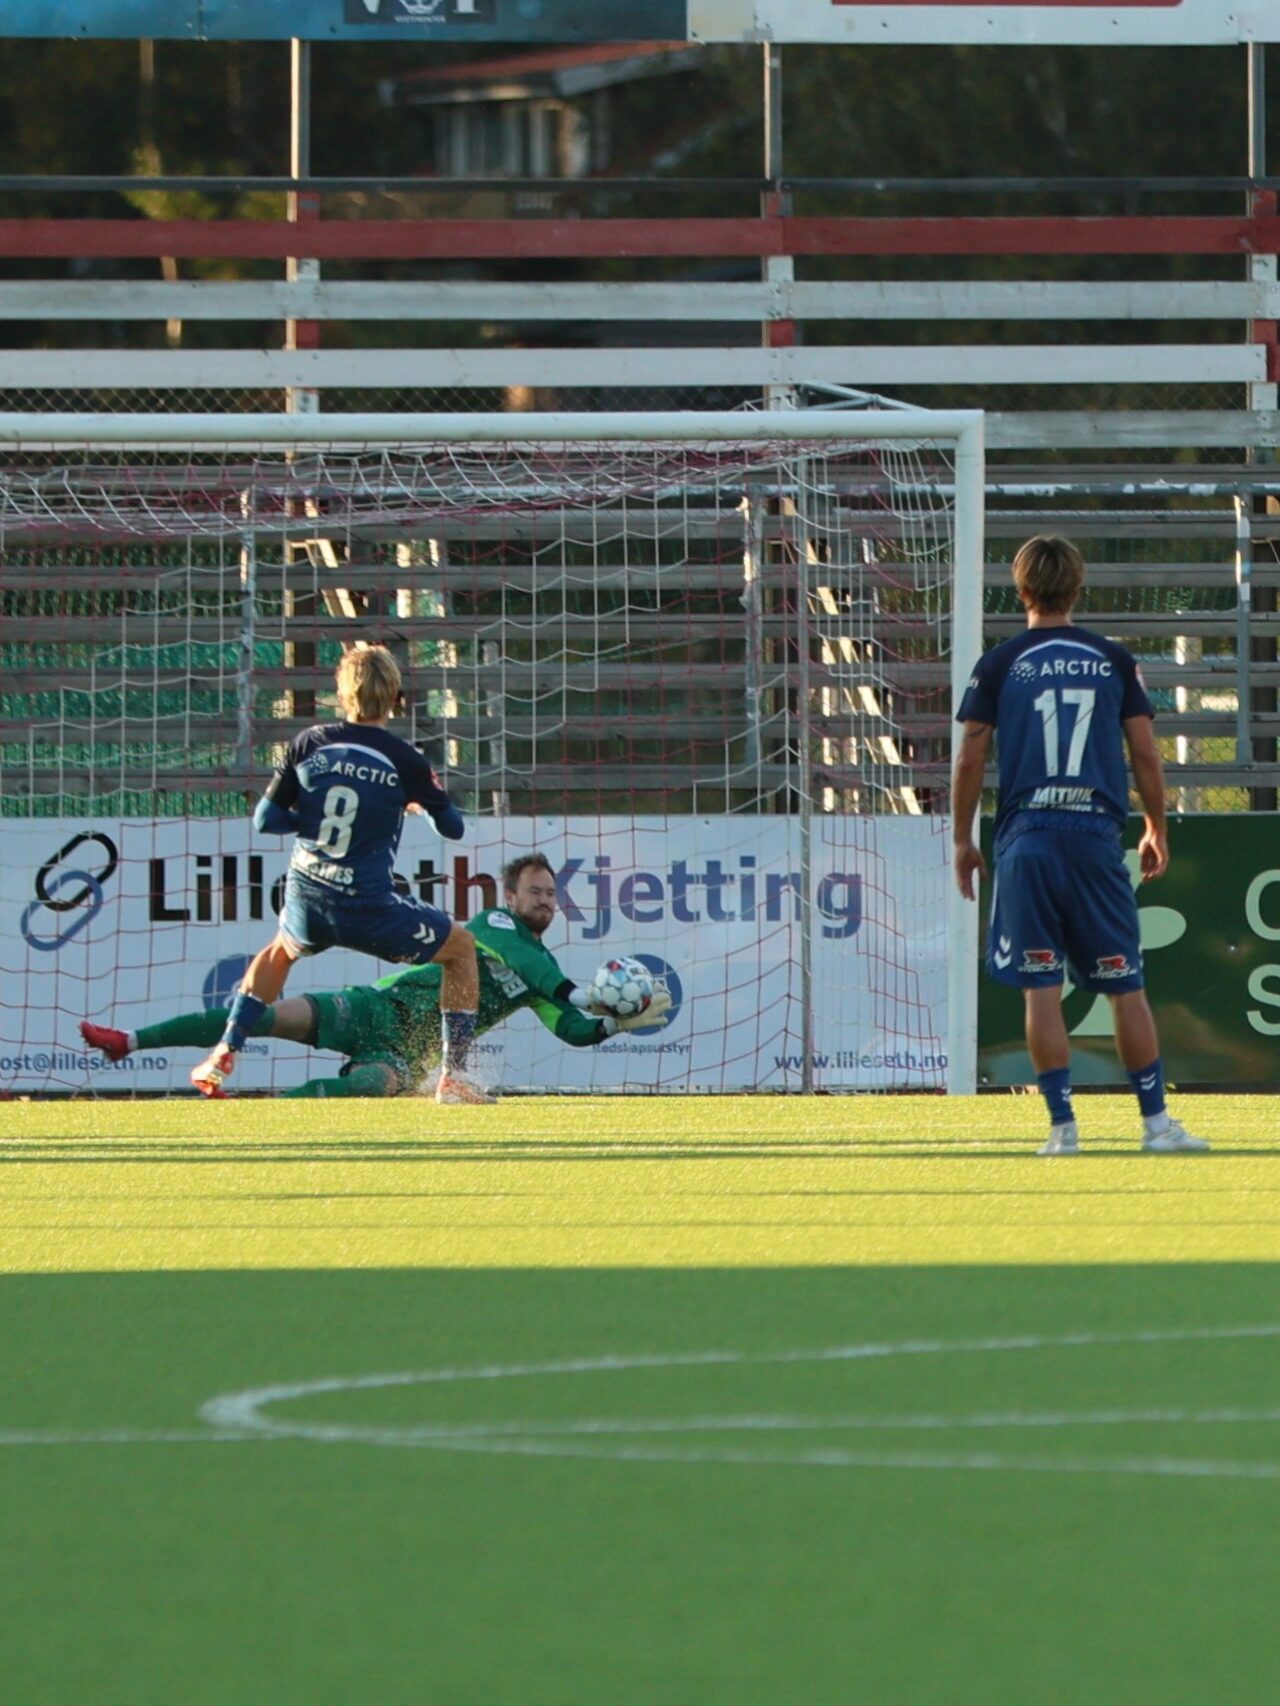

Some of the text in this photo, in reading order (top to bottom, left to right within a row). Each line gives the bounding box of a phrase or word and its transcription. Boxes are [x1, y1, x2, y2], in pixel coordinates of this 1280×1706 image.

[1040, 660, 1112, 677] ARCTIC
[1034, 688, 1096, 777] 17
[330, 761, 399, 787] ARCTIC
[317, 785, 360, 859] 8
